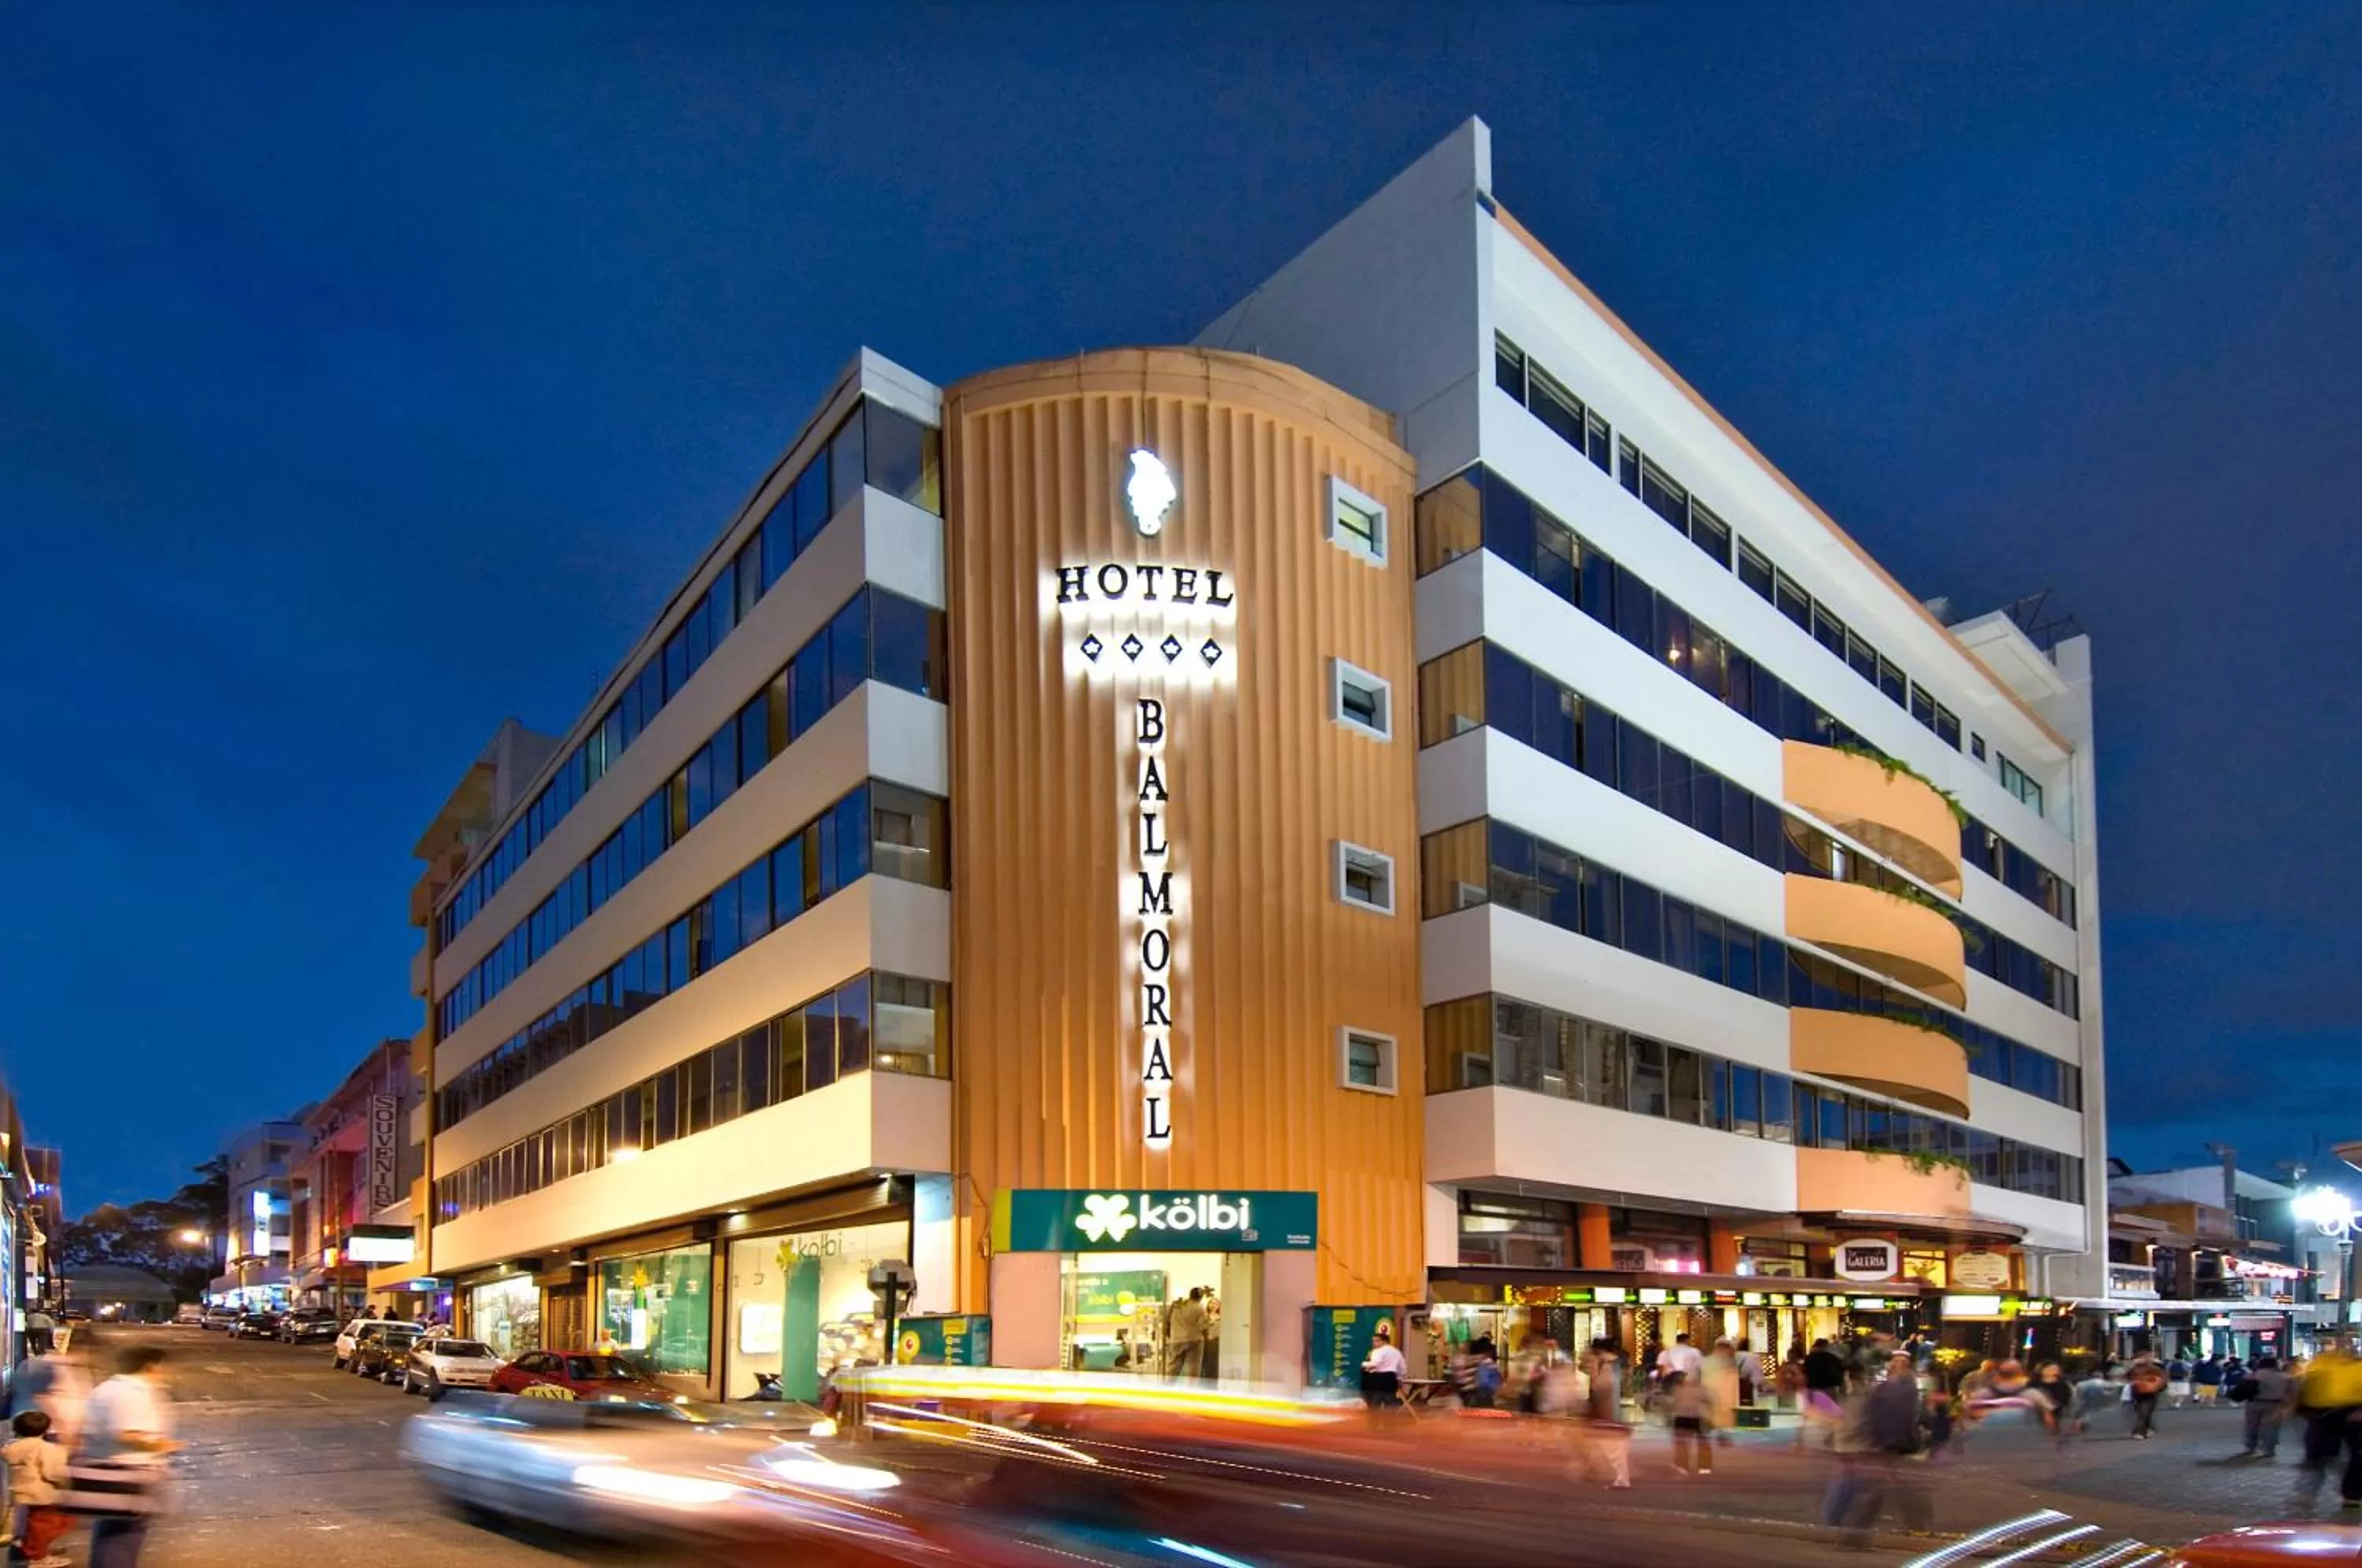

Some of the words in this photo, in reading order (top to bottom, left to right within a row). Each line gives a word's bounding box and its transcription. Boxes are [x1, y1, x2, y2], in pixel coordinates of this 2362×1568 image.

[1056, 564, 1234, 607] HOTEL
[1138, 699, 1173, 1138] BALMORAL
[1140, 1194, 1250, 1230] kölbi
